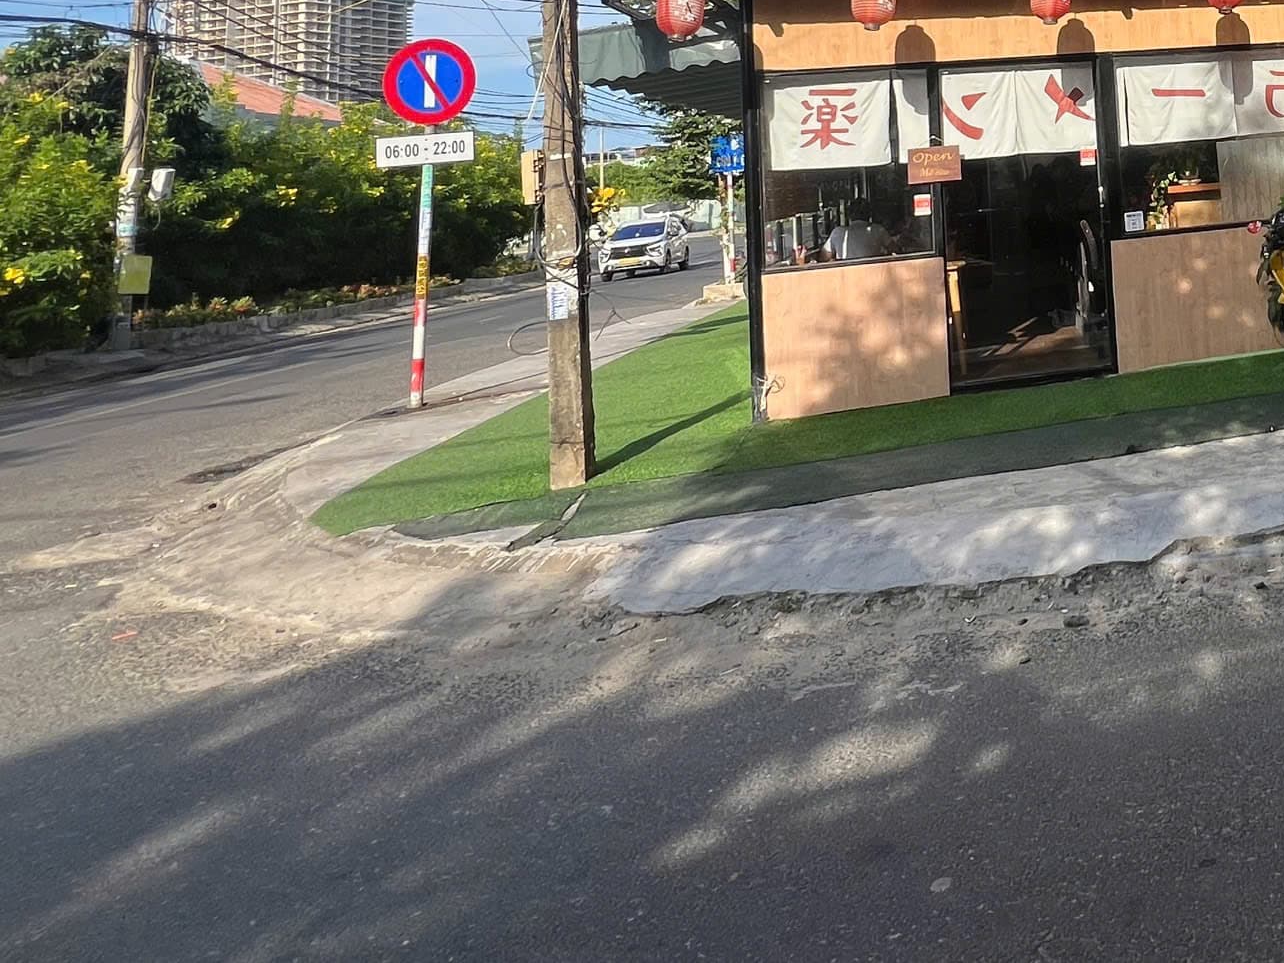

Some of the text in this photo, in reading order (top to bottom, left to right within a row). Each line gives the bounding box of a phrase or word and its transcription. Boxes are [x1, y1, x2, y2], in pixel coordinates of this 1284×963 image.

[385, 144, 419, 159] 06:00
[433, 139, 465, 155] 22:00
[912, 152, 953, 166] Open
